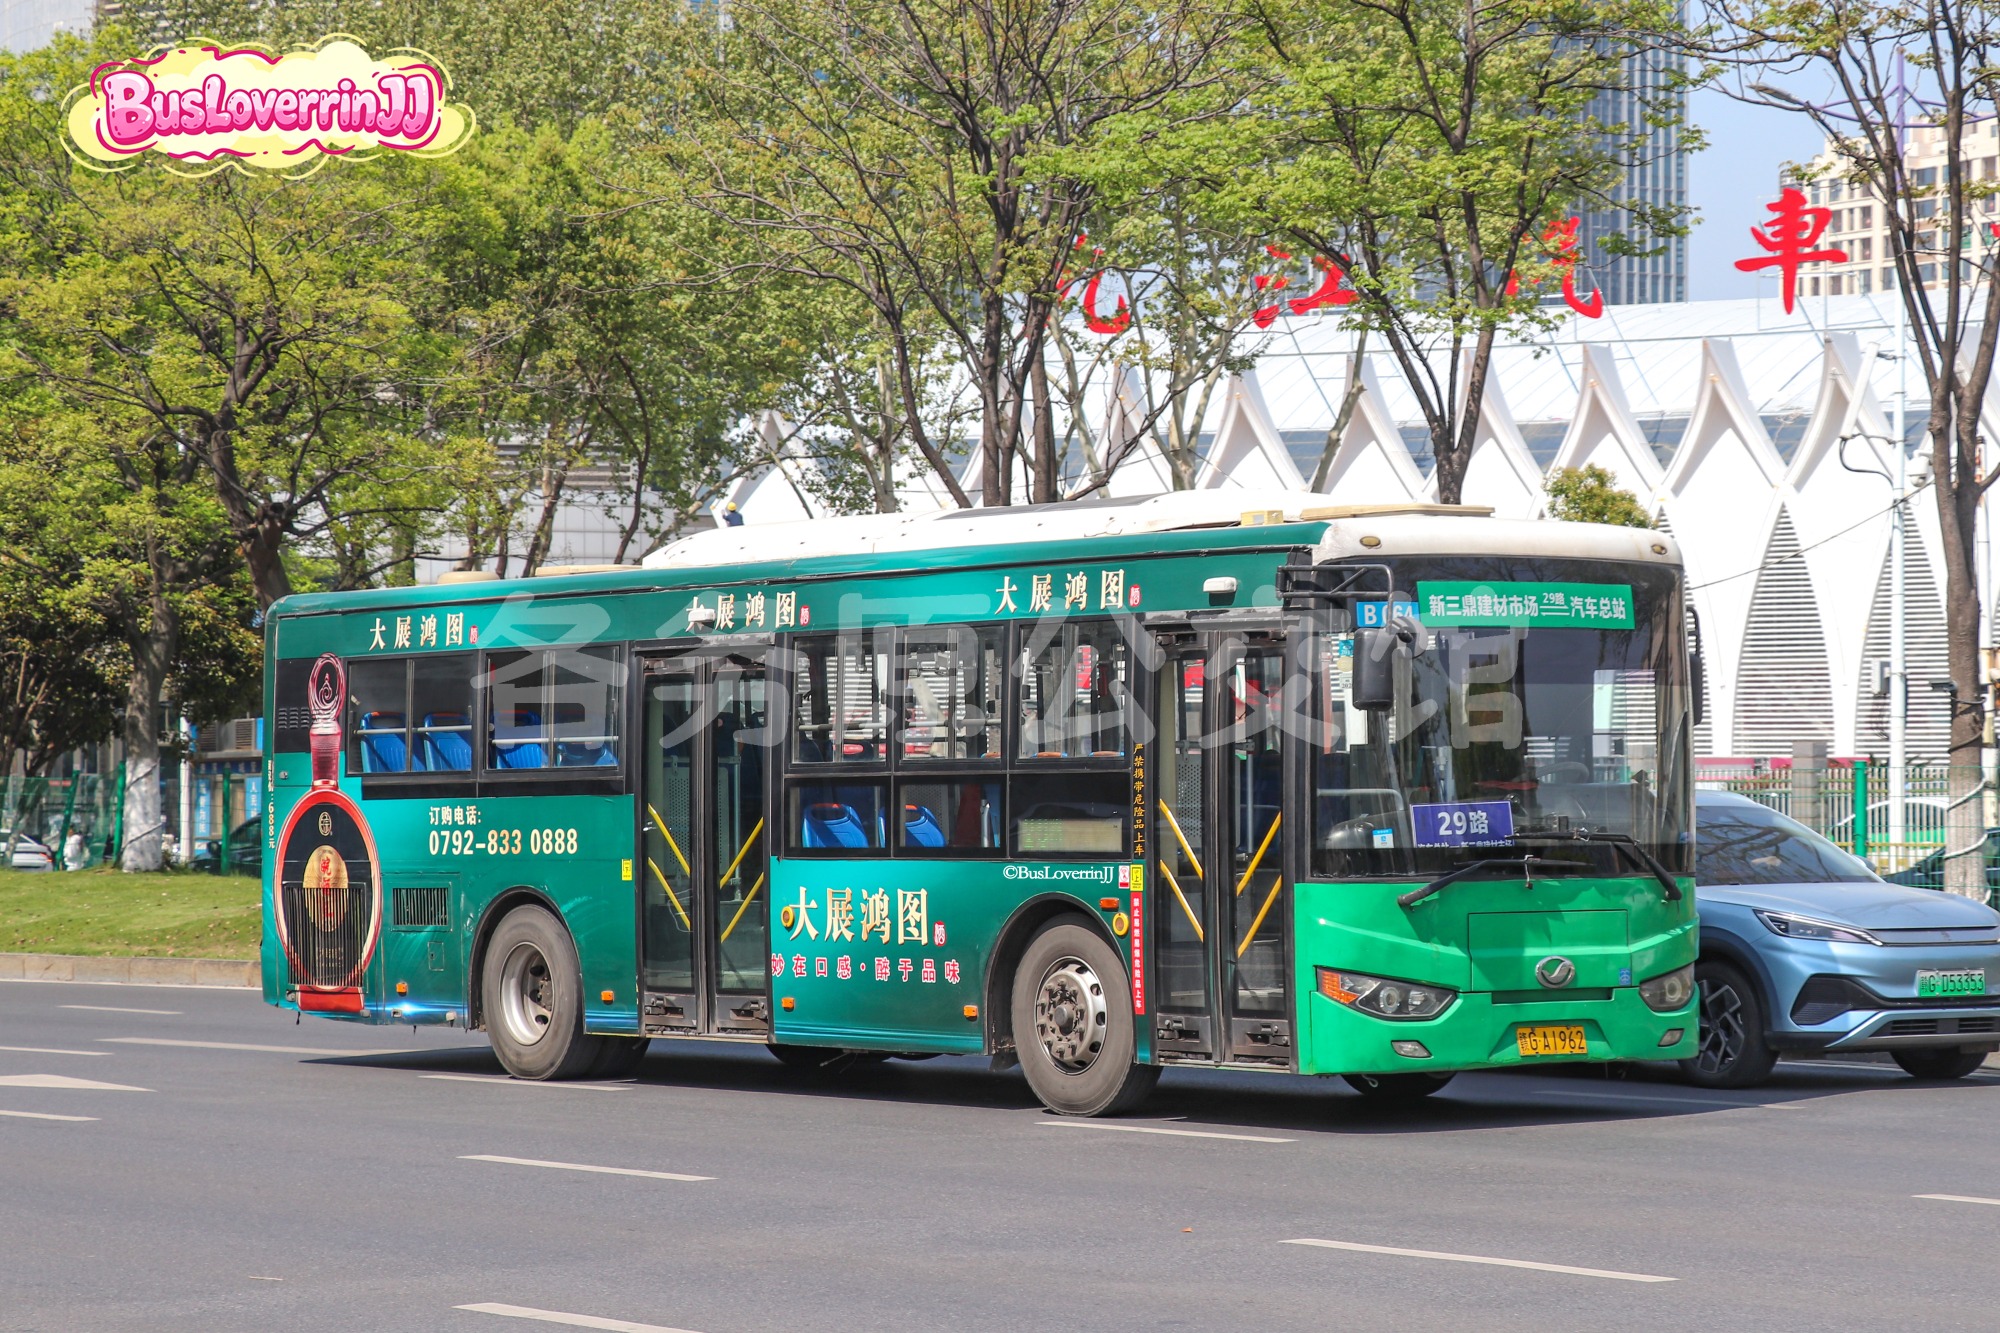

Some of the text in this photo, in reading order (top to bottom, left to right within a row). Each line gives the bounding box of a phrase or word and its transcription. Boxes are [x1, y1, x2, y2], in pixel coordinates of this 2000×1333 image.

[995, 567, 1125, 616] 大展鸿图
[1428, 594, 1539, 618] 新三鼎建材市场
[1570, 595, 1627, 620] 汽车总站
[369, 611, 465, 651] 大展鸿图
[685, 590, 798, 634] 大展鸿图
[1363, 604, 1377, 624] B
[1133, 743, 1146, 857] 严禁携带危险品上车
[429, 828, 578, 856] 0792-833 0888
[1436, 810, 1489, 836] 29路
[788, 886, 930, 947] 大展鸿图
